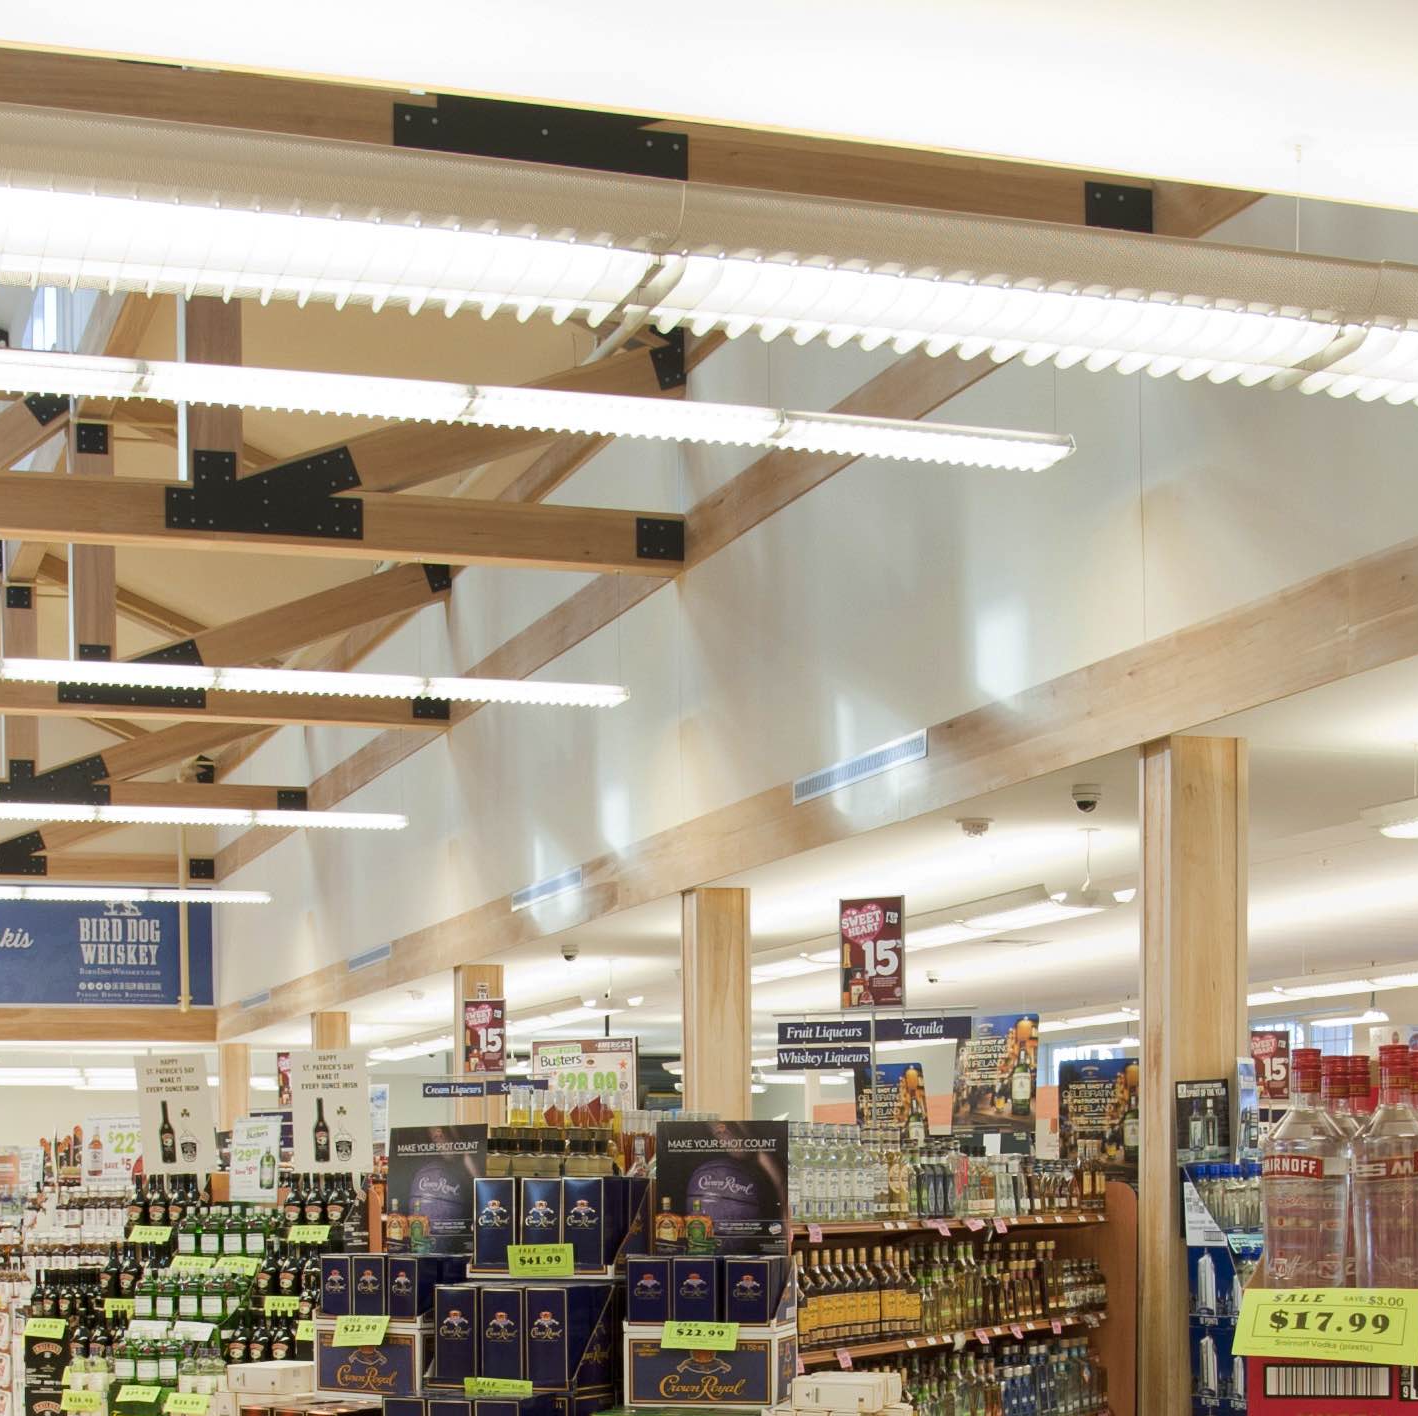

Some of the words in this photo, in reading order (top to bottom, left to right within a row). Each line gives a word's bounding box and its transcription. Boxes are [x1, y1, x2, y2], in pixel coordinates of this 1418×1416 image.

[841, 910, 881, 929] SWEET
[79, 917, 123, 942] BIRD
[127, 918, 161, 943] DOG
[848, 923, 879, 938] HEART
[81, 944, 159, 966] WHISKEY
[786, 1027, 813, 1039] Fruit
[815, 1025, 862, 1041] Liqueurs
[903, 1021, 944, 1036] Tequila
[779, 1051, 823, 1066] Whiskey
[824, 1050, 870, 1065] Liqueurs
[425, 1085, 450, 1095] Cream
[451, 1085, 482, 1097] Liqueurs
[668, 1139, 693, 1149] MAKE
[693, 1139, 718, 1148] YOUR
[719, 1139, 743, 1148] SHOT
[745, 1138, 777, 1148] COUNT
[518, 1255, 562, 1267] $41.99
[1268, 1310, 1392, 1336] $17.99
